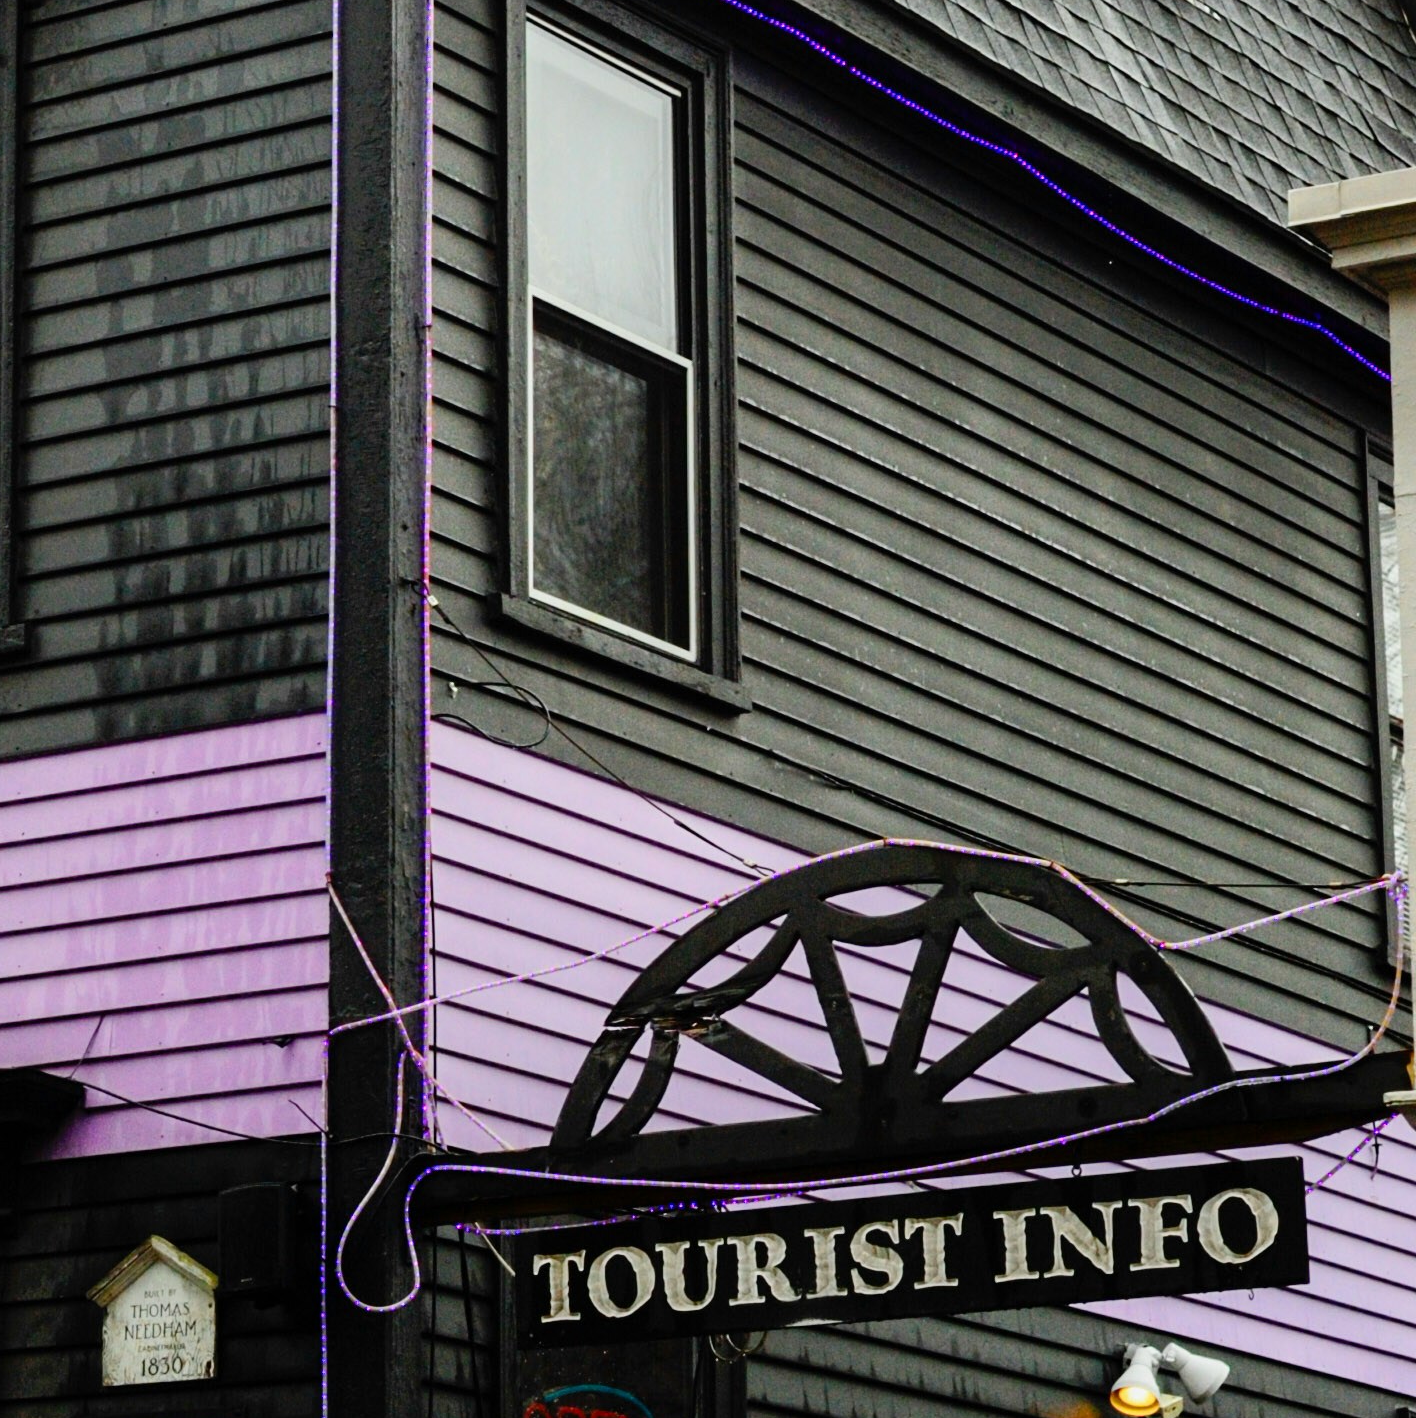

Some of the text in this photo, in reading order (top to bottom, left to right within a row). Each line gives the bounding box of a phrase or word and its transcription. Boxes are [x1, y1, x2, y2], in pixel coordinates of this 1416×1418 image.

[532, 1187, 1280, 1324] TOURIST INFO
[130, 1302, 190, 1318] THOMAS
[125, 1320, 197, 1341] NEEDHAM
[142, 1355, 184, 1377] 1830
